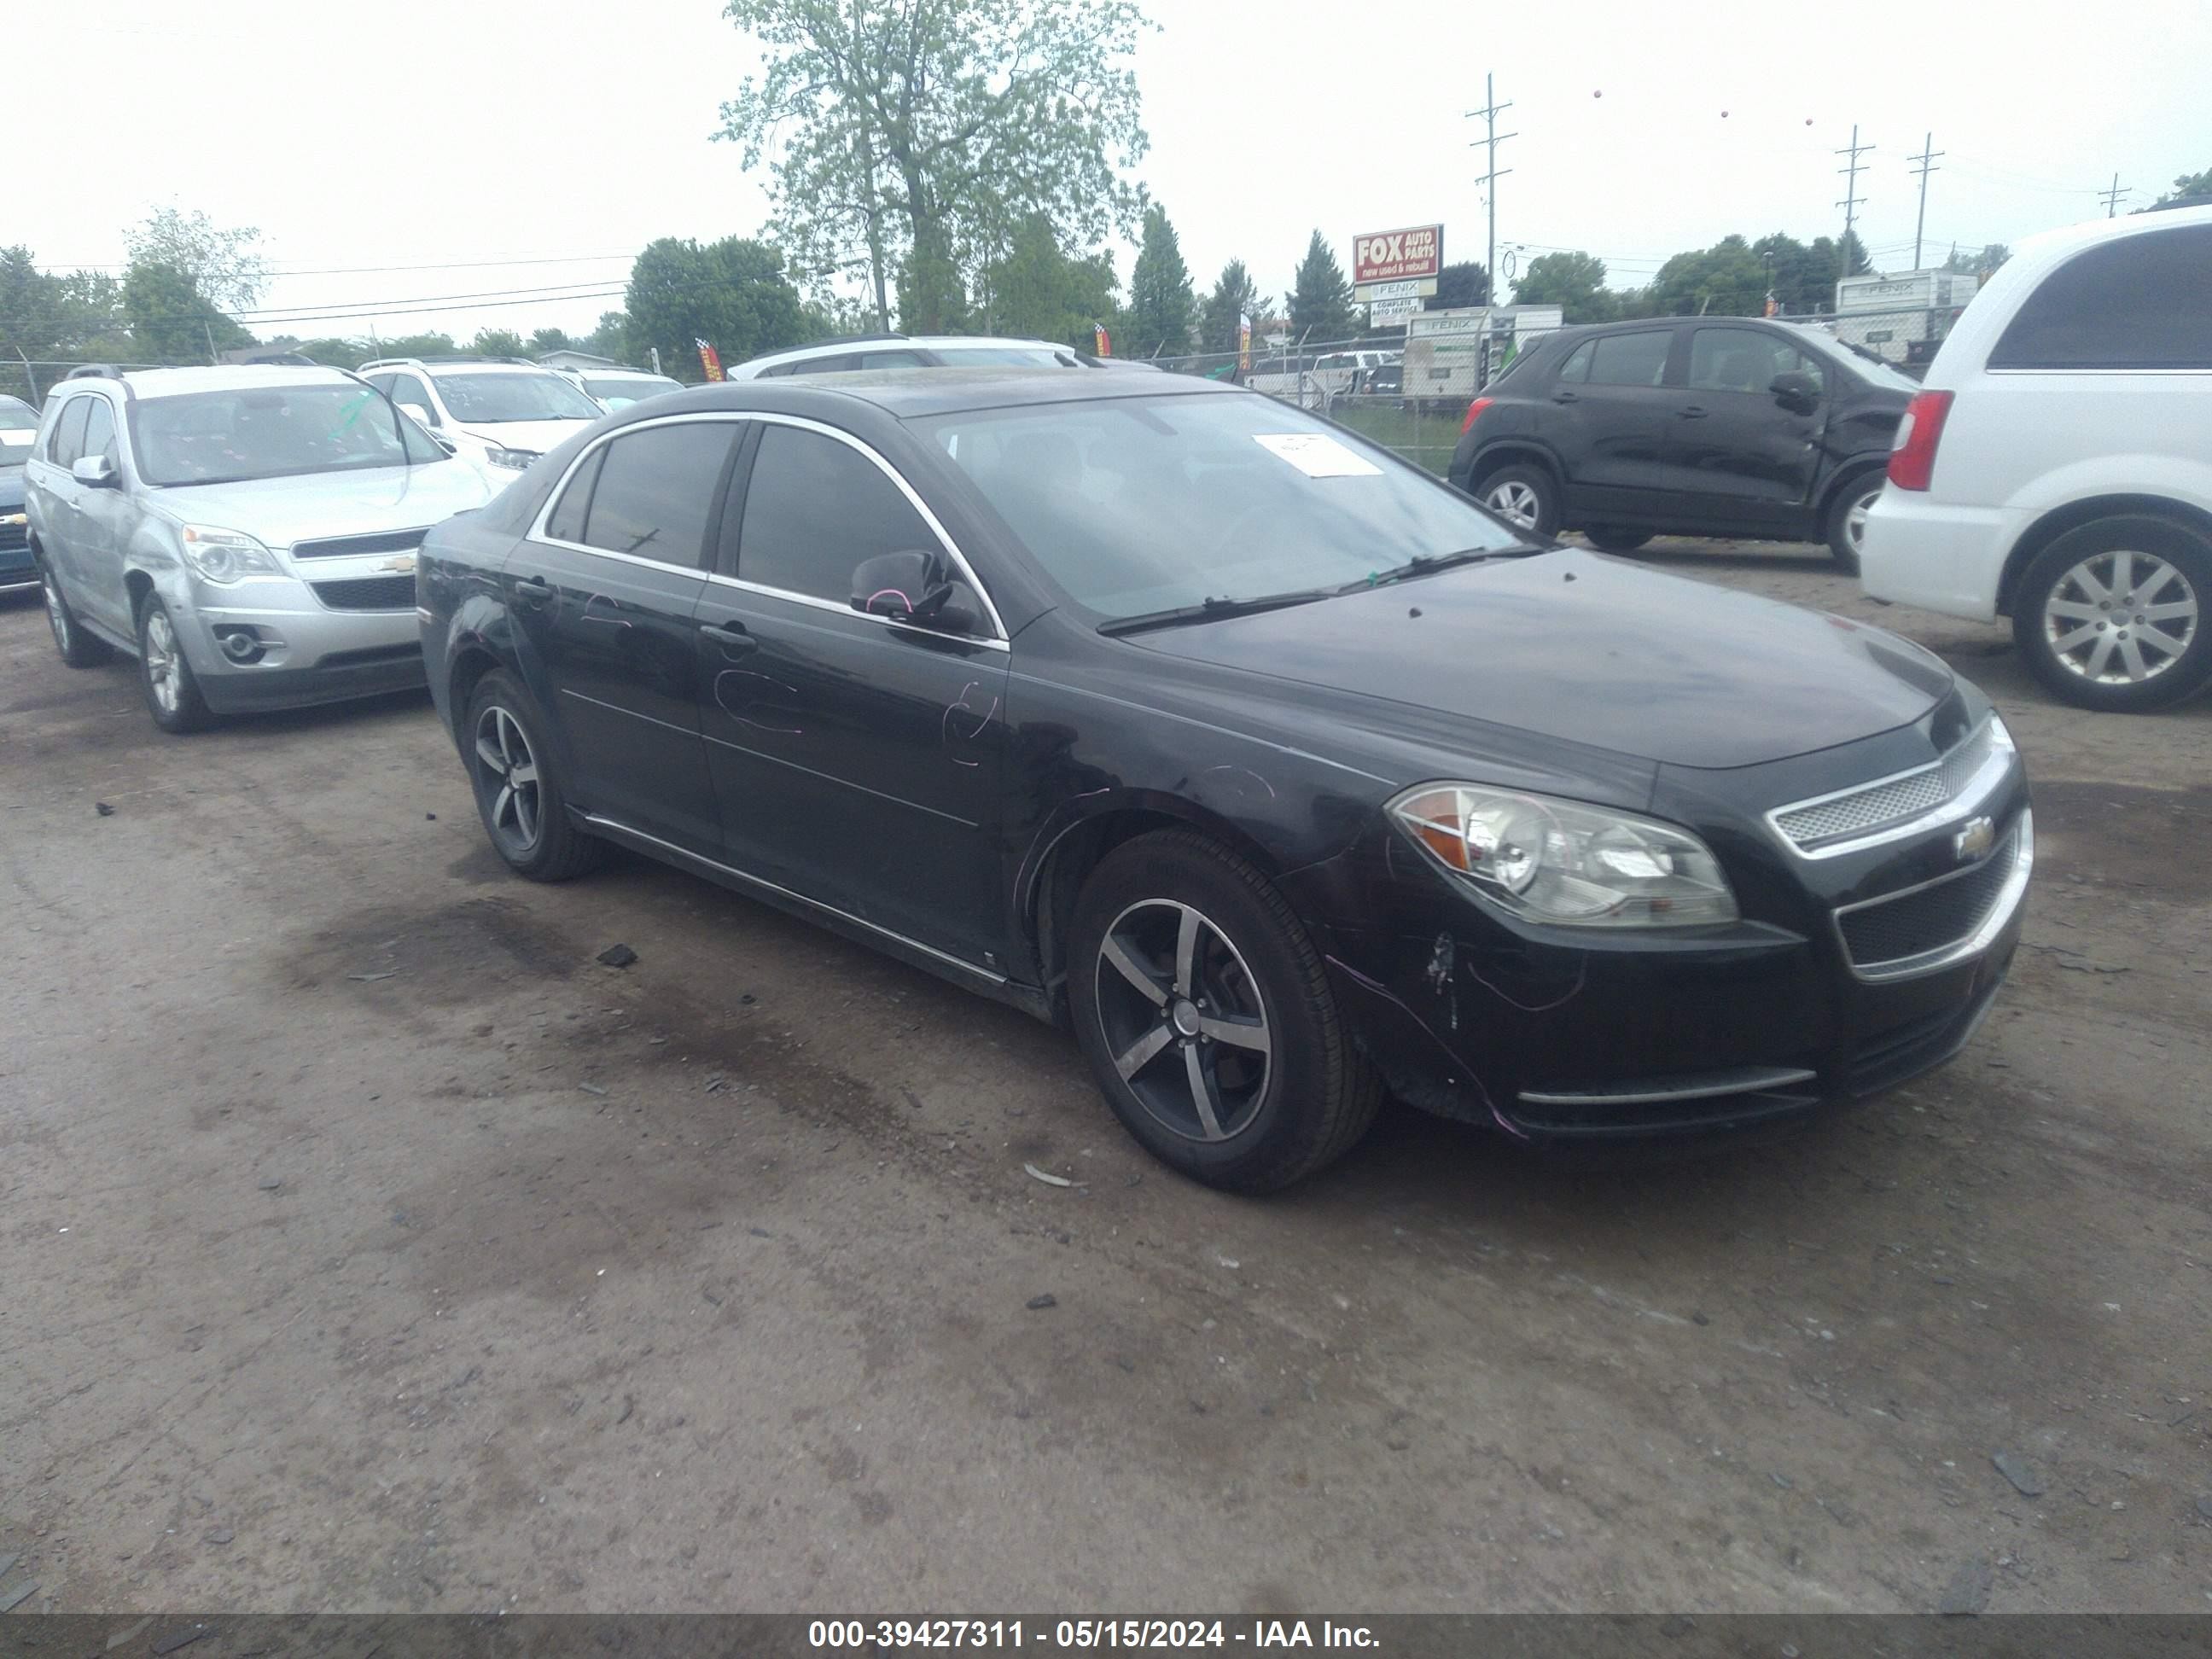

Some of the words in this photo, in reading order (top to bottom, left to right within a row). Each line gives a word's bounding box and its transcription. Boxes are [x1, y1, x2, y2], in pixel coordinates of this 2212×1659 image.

[1406, 231, 1432, 247] AUTO
[1358, 235, 1404, 266] FOX
[1405, 244, 1435, 259] PARTS
[1380, 282, 1417, 294] FENIX
[1432, 320, 1470, 329] FENIX
